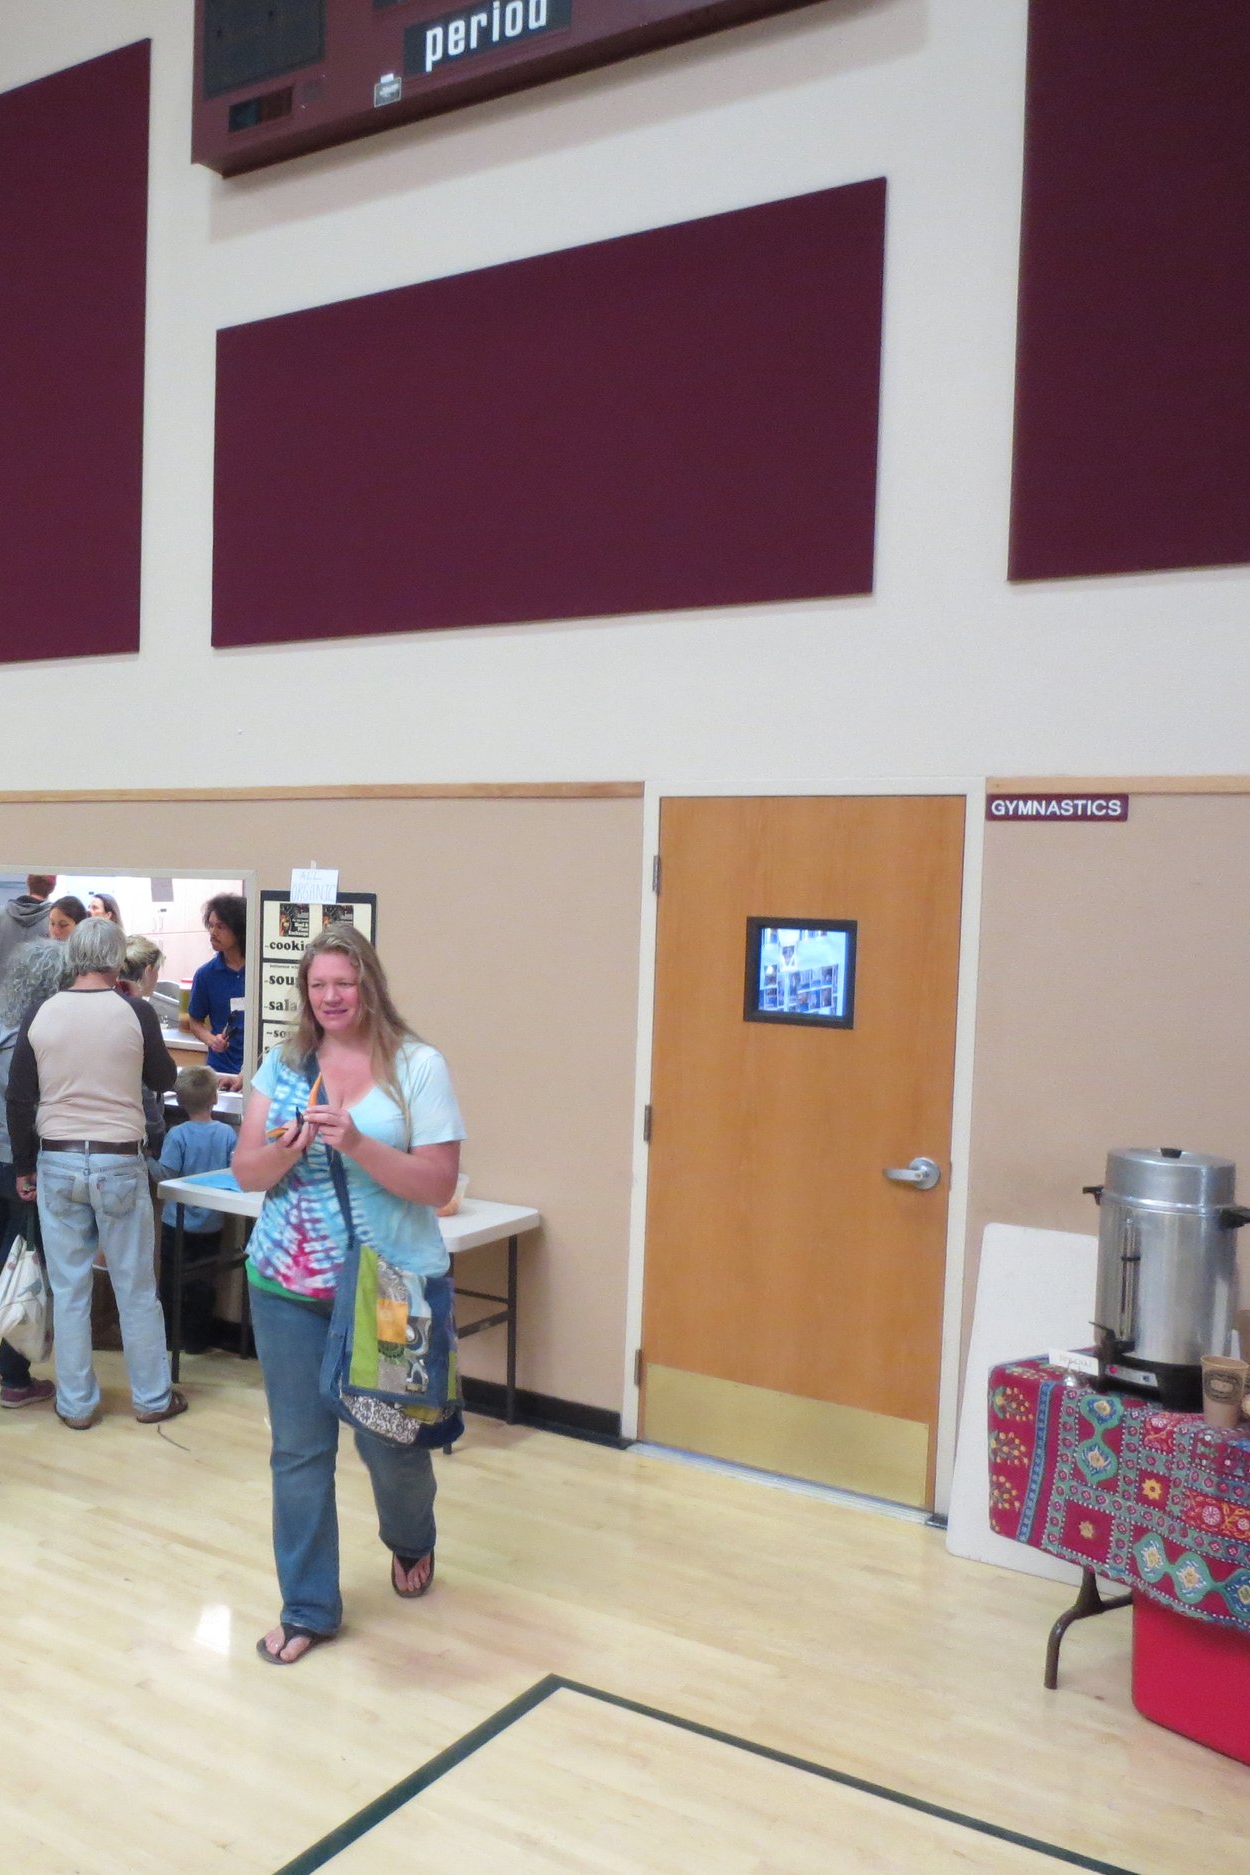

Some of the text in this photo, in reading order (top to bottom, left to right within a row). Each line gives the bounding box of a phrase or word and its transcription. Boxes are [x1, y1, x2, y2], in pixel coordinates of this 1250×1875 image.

[425, 0, 547, 73] period
[991, 799, 1122, 816] GYMNASTICS
[300, 871, 322, 881] ALL
[291, 883, 335, 903] ORGANIC
